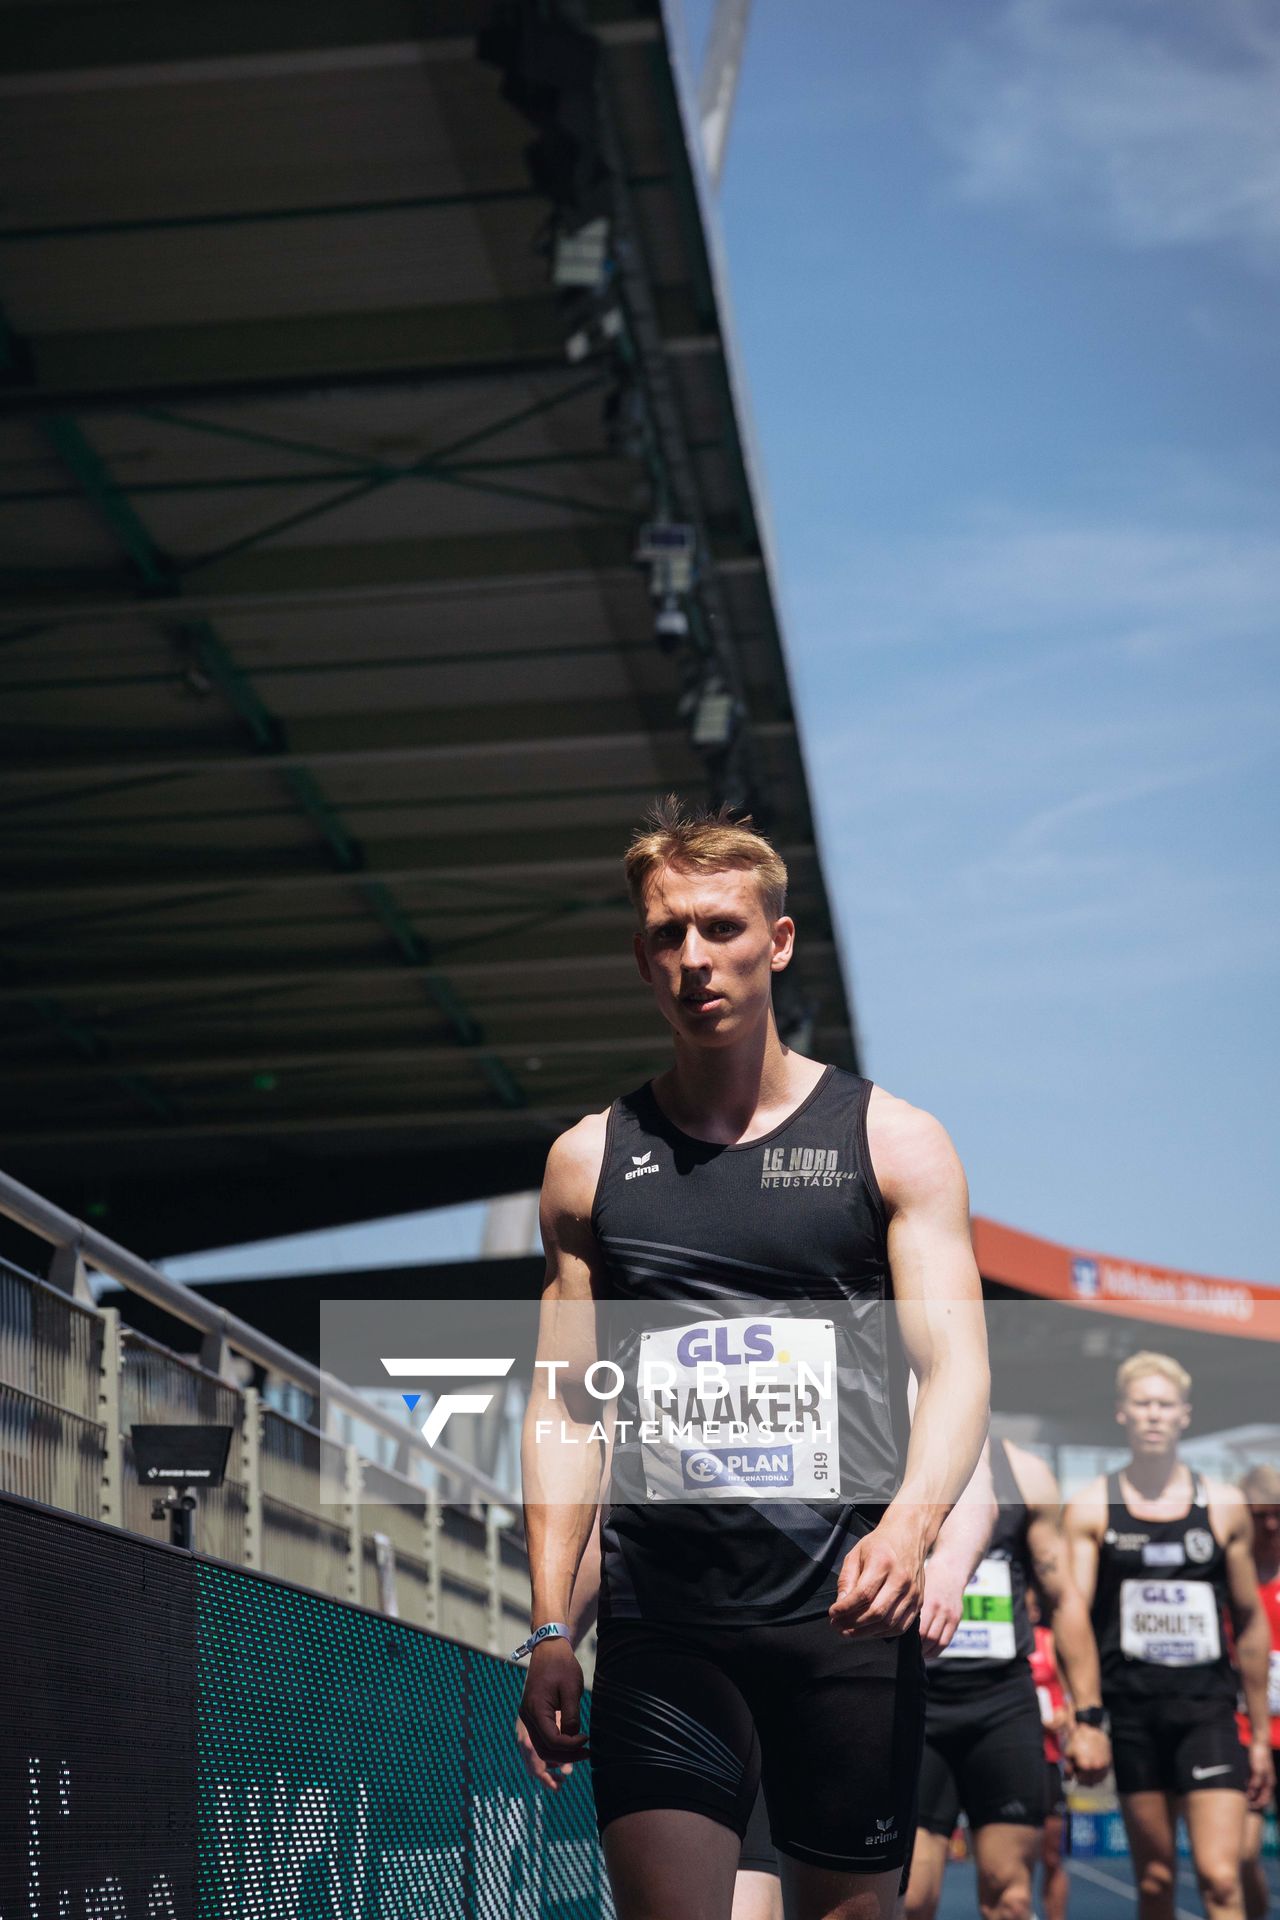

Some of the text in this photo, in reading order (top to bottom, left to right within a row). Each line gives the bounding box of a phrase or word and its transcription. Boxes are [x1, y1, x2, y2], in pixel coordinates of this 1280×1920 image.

[763, 1147, 839, 1171] LG NORD
[625, 1164, 660, 1181] erima
[760, 1177, 843, 1189] NEUSTADT
[676, 1324, 775, 1367] GLS
[654, 1384, 822, 1436] HAAKER
[727, 1454, 789, 1473] PLAN
[813, 1452, 828, 1481] 615
[1142, 1586, 1186, 1604] GLS
